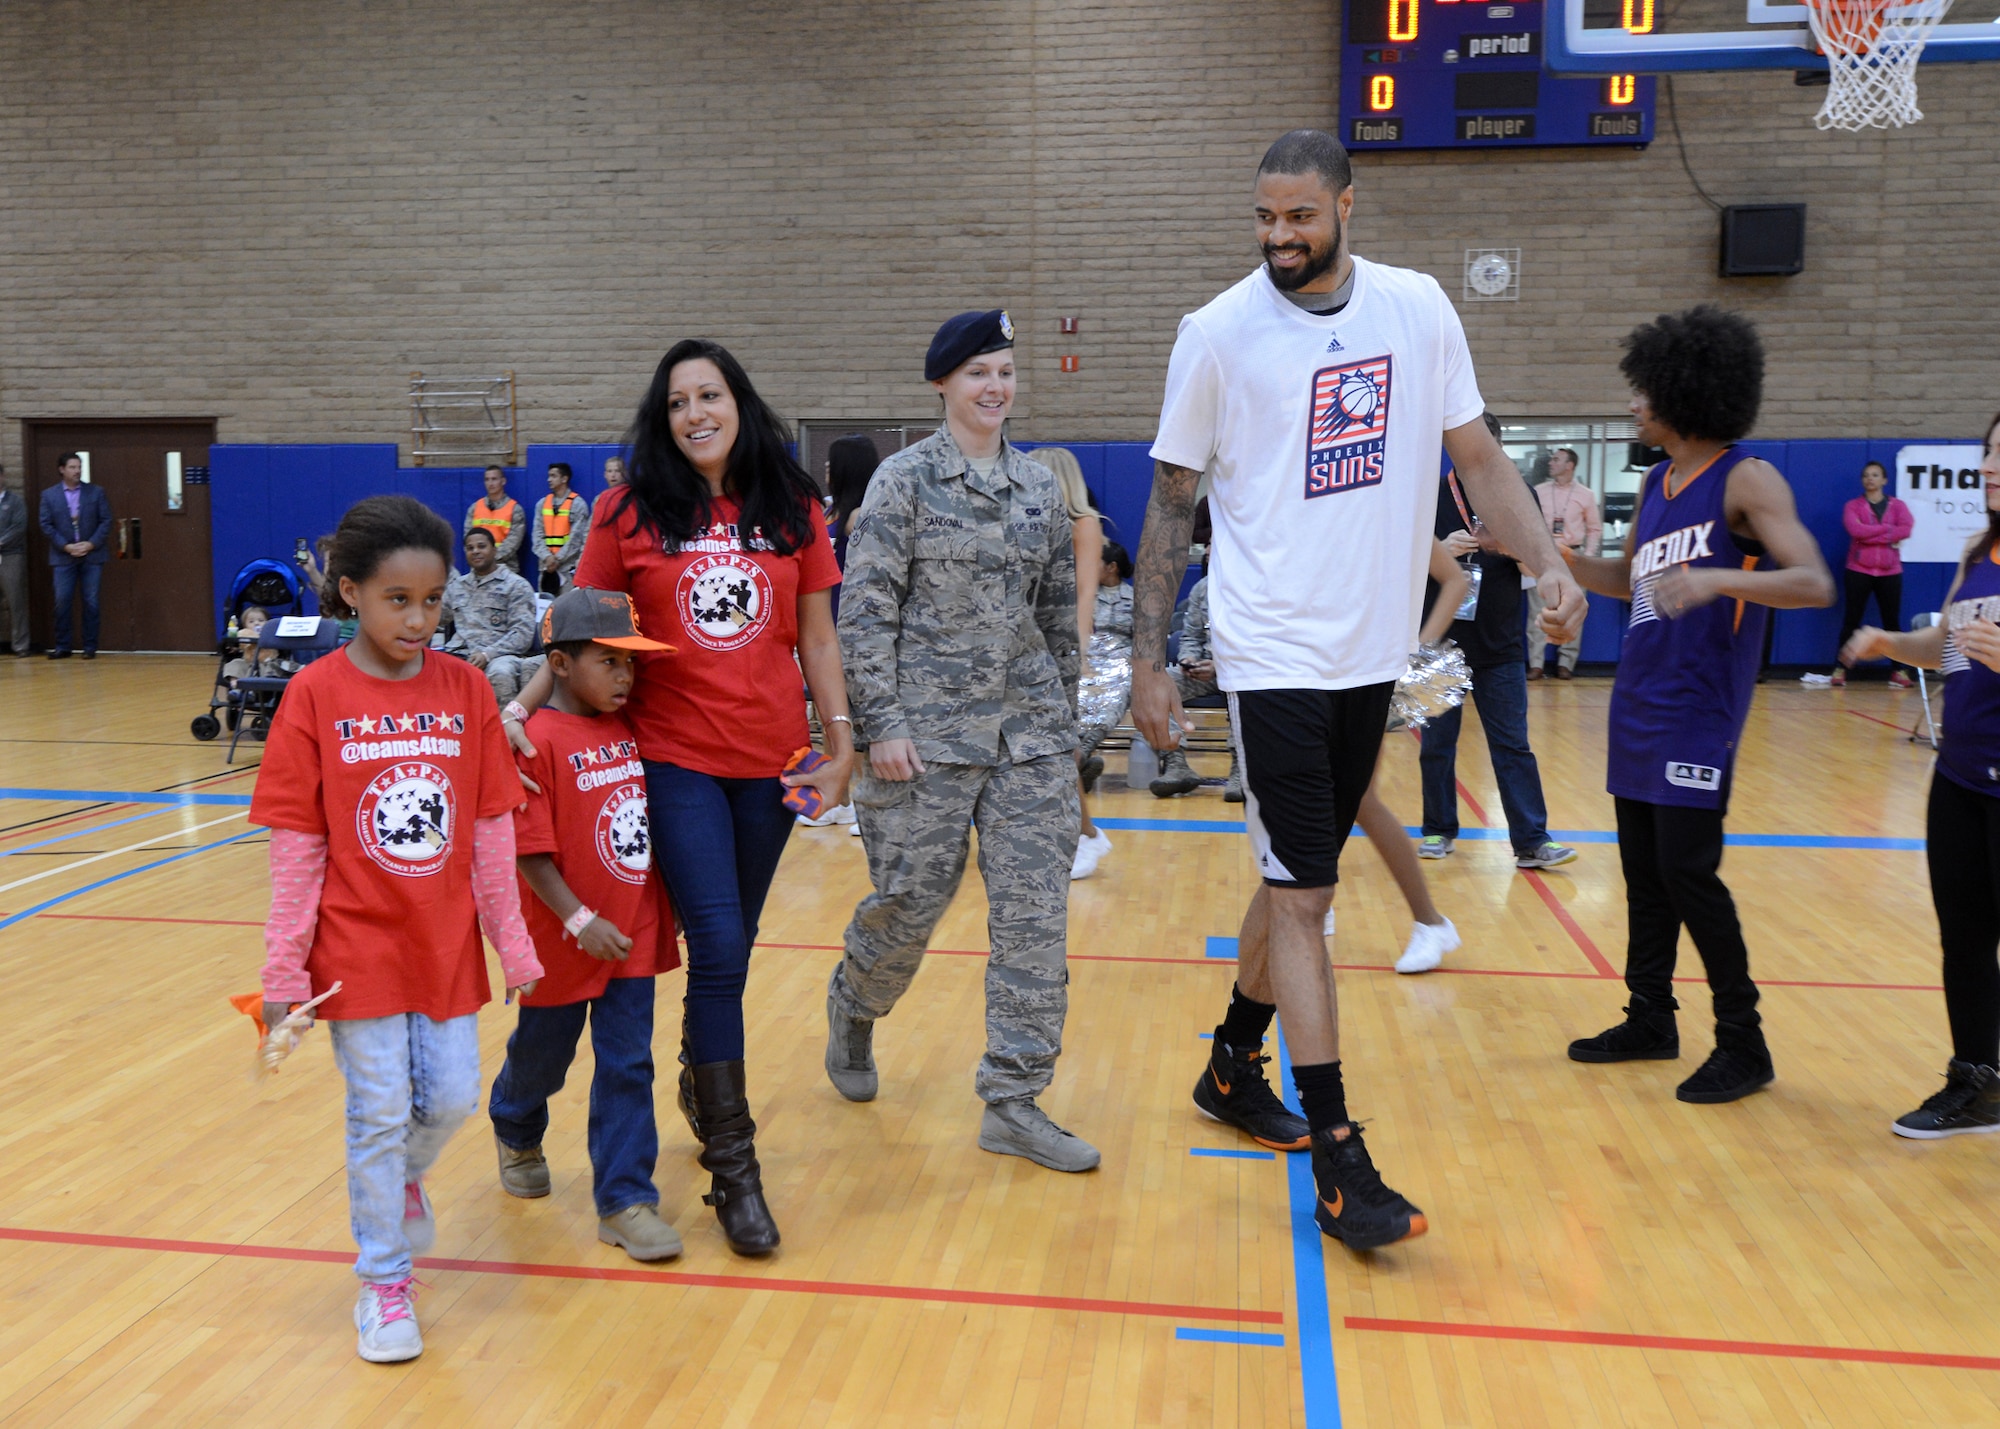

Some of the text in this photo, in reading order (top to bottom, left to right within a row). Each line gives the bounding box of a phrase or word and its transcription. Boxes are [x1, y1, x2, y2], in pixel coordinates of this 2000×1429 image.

[1469, 33, 1531, 58] period
[1371, 75, 1395, 111] 0
[1355, 121, 1398, 141] fouls
[1465, 116, 1526, 139] player
[1593, 115, 1638, 136] fouls
[1311, 440, 1384, 464] PHOENIX
[1310, 451, 1383, 493] SUNS
[1907, 464, 1981, 490] Tha
[1935, 498, 1987, 514] to ou
[924, 517, 963, 529] SANDOVAL
[718, 633, 748, 648] PROGRAM
[341, 736, 460, 764] @teams4taps
[568, 740, 631, 772] TAP
